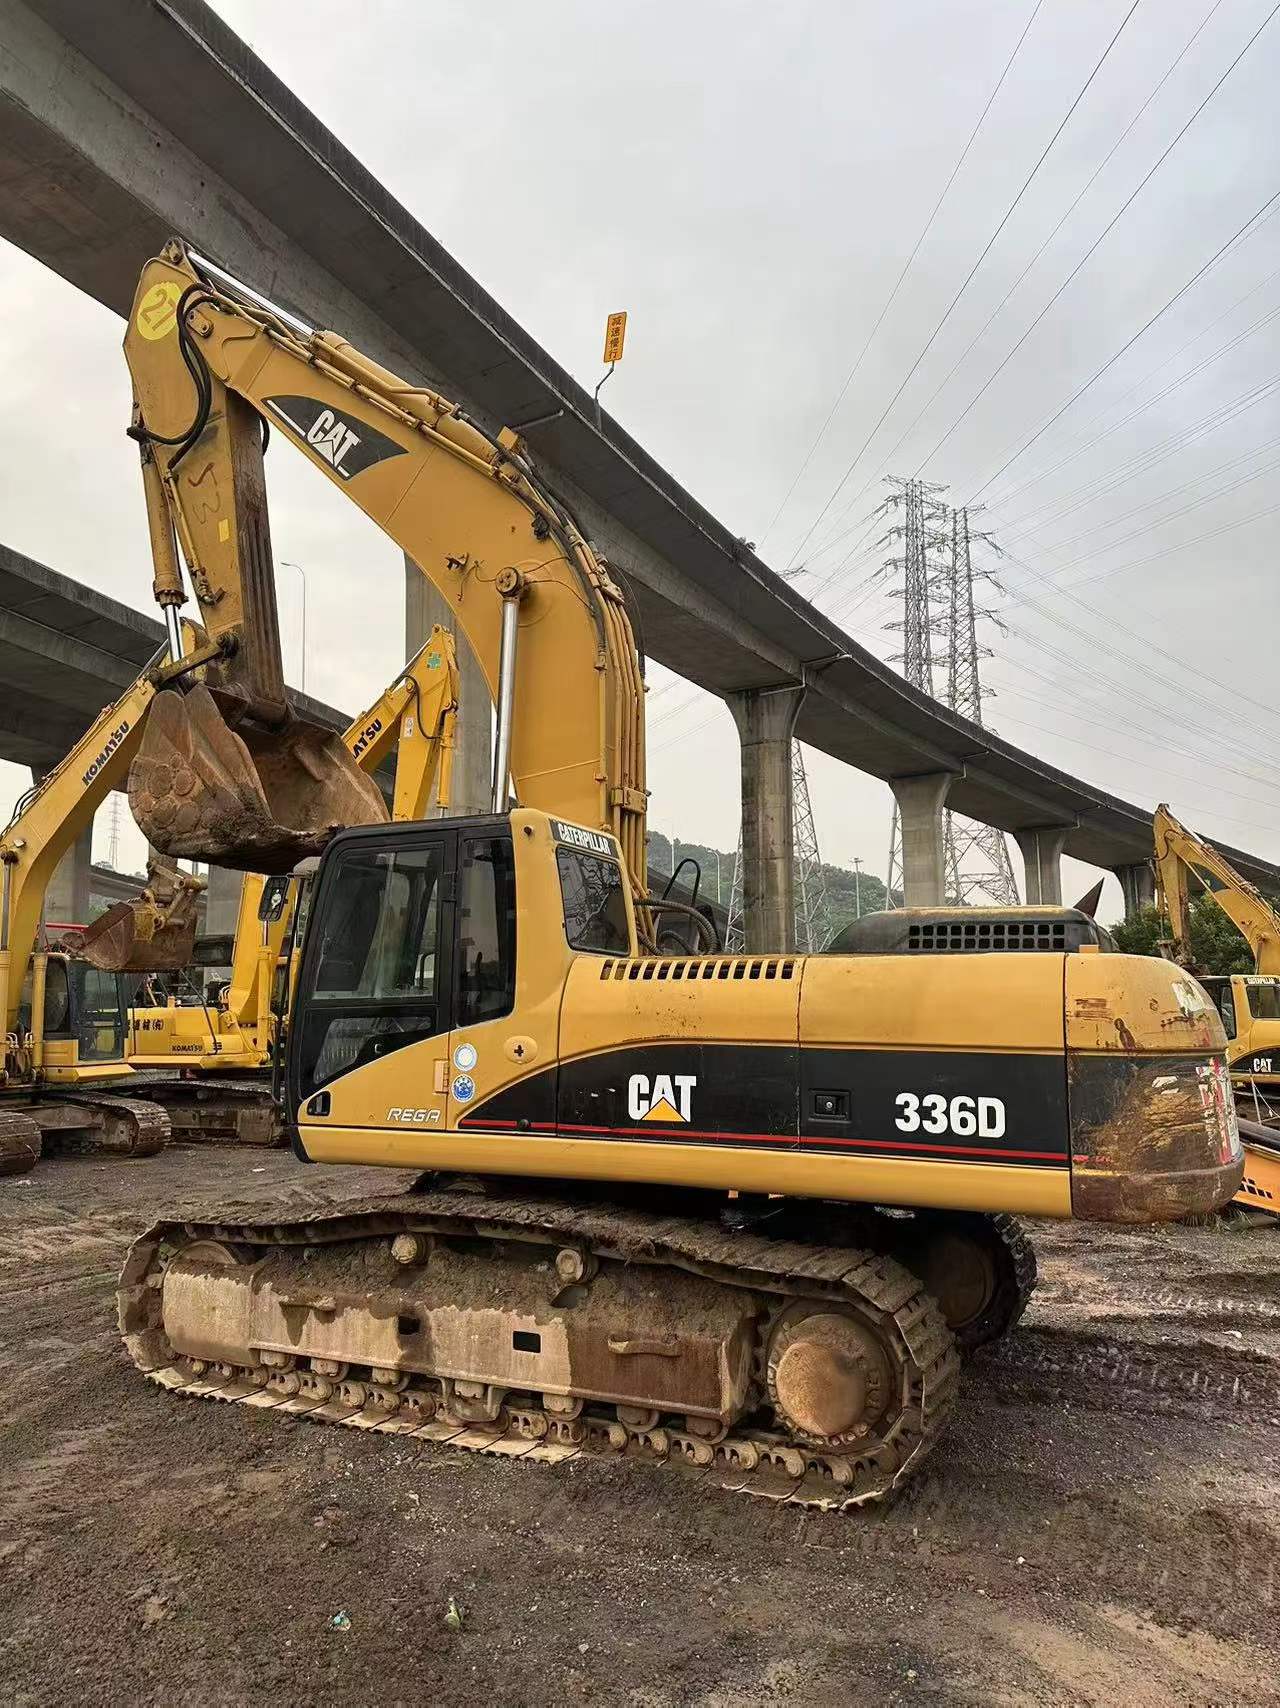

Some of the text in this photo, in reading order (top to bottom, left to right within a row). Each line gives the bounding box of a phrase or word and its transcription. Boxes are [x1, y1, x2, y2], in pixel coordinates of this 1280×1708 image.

[307, 409, 361, 467] CAT
[81, 720, 130, 786] KOMATSU
[353, 718, 382, 759] ATSU
[557, 822, 612, 856] CATERPILLAR
[171, 1044, 203, 1052] KOMATSU
[1253, 1058, 1273, 1073] CAT
[386, 1107, 441, 1123] REGA
[628, 1074, 697, 1122] CAT
[894, 1092, 1006, 1138] 336D
